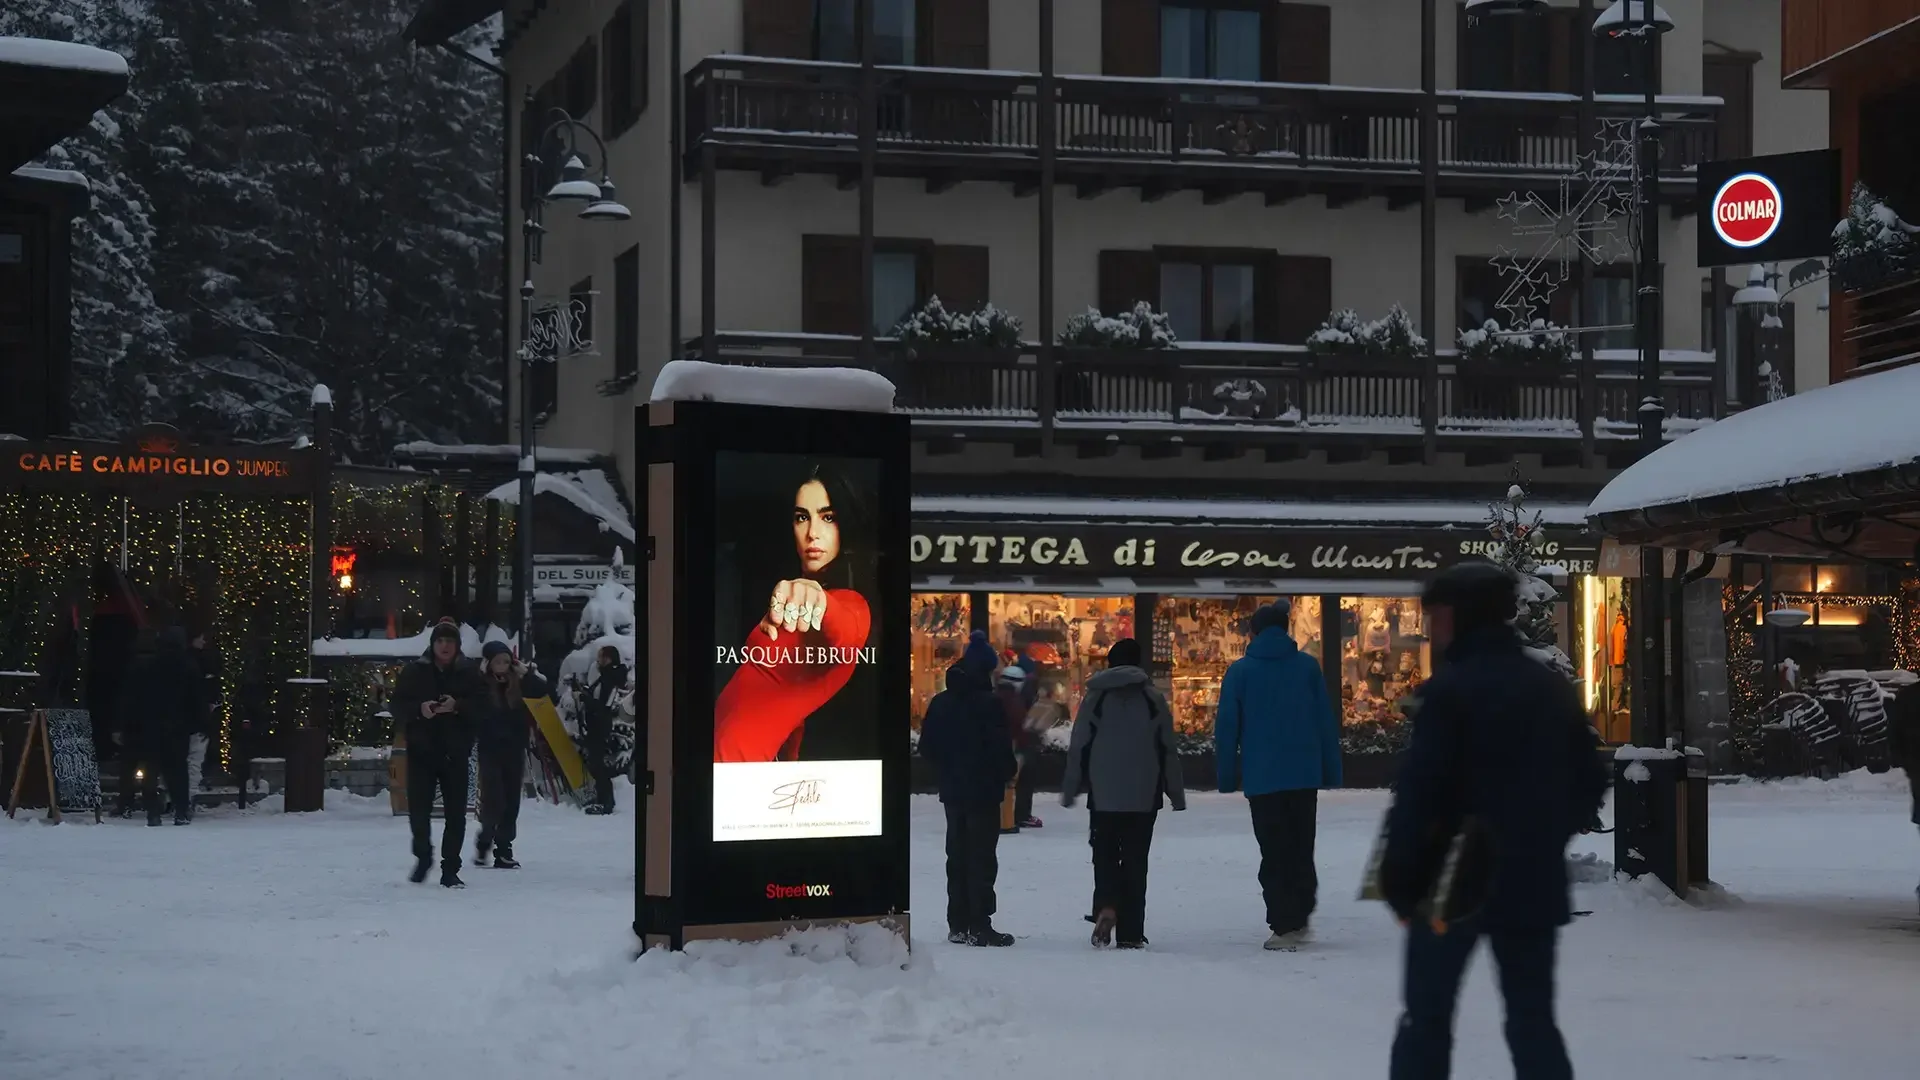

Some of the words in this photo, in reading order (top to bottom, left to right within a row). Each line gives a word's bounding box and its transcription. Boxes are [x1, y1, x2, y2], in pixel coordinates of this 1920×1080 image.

[1719, 198, 1775, 222] COLMAR
[92, 455, 230, 476] CAMPIGLIO
[1113, 539, 1156, 566] di
[538, 570, 567, 580] DEL
[716, 646, 877, 667] PASQUALEBRUNI
